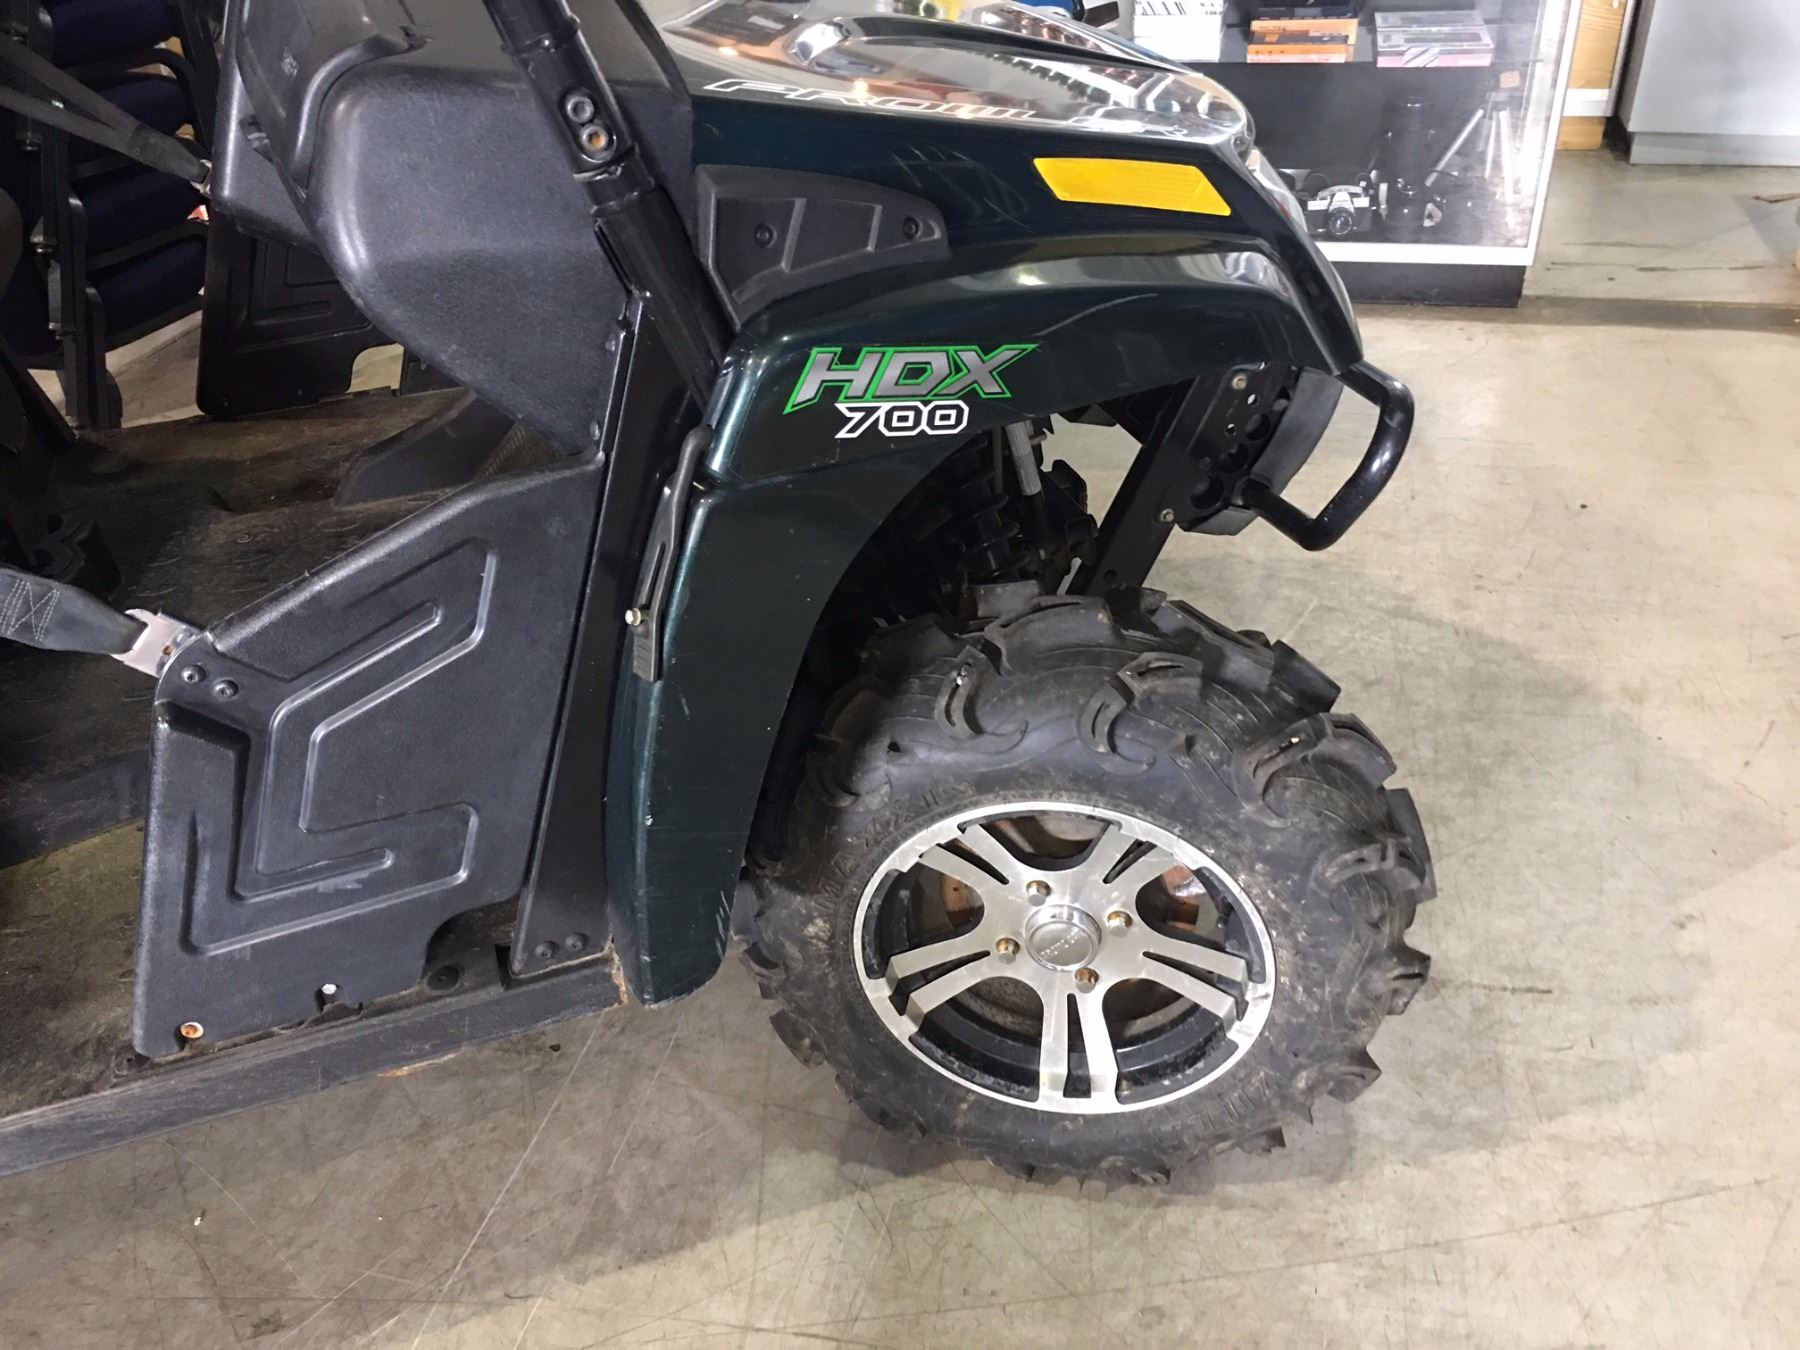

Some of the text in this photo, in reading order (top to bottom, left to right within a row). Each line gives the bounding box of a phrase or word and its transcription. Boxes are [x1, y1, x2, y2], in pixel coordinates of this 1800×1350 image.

[703, 78, 1188, 138] PROWL
[783, 343, 1040, 415] HDX
[834, 399, 969, 439] 700
